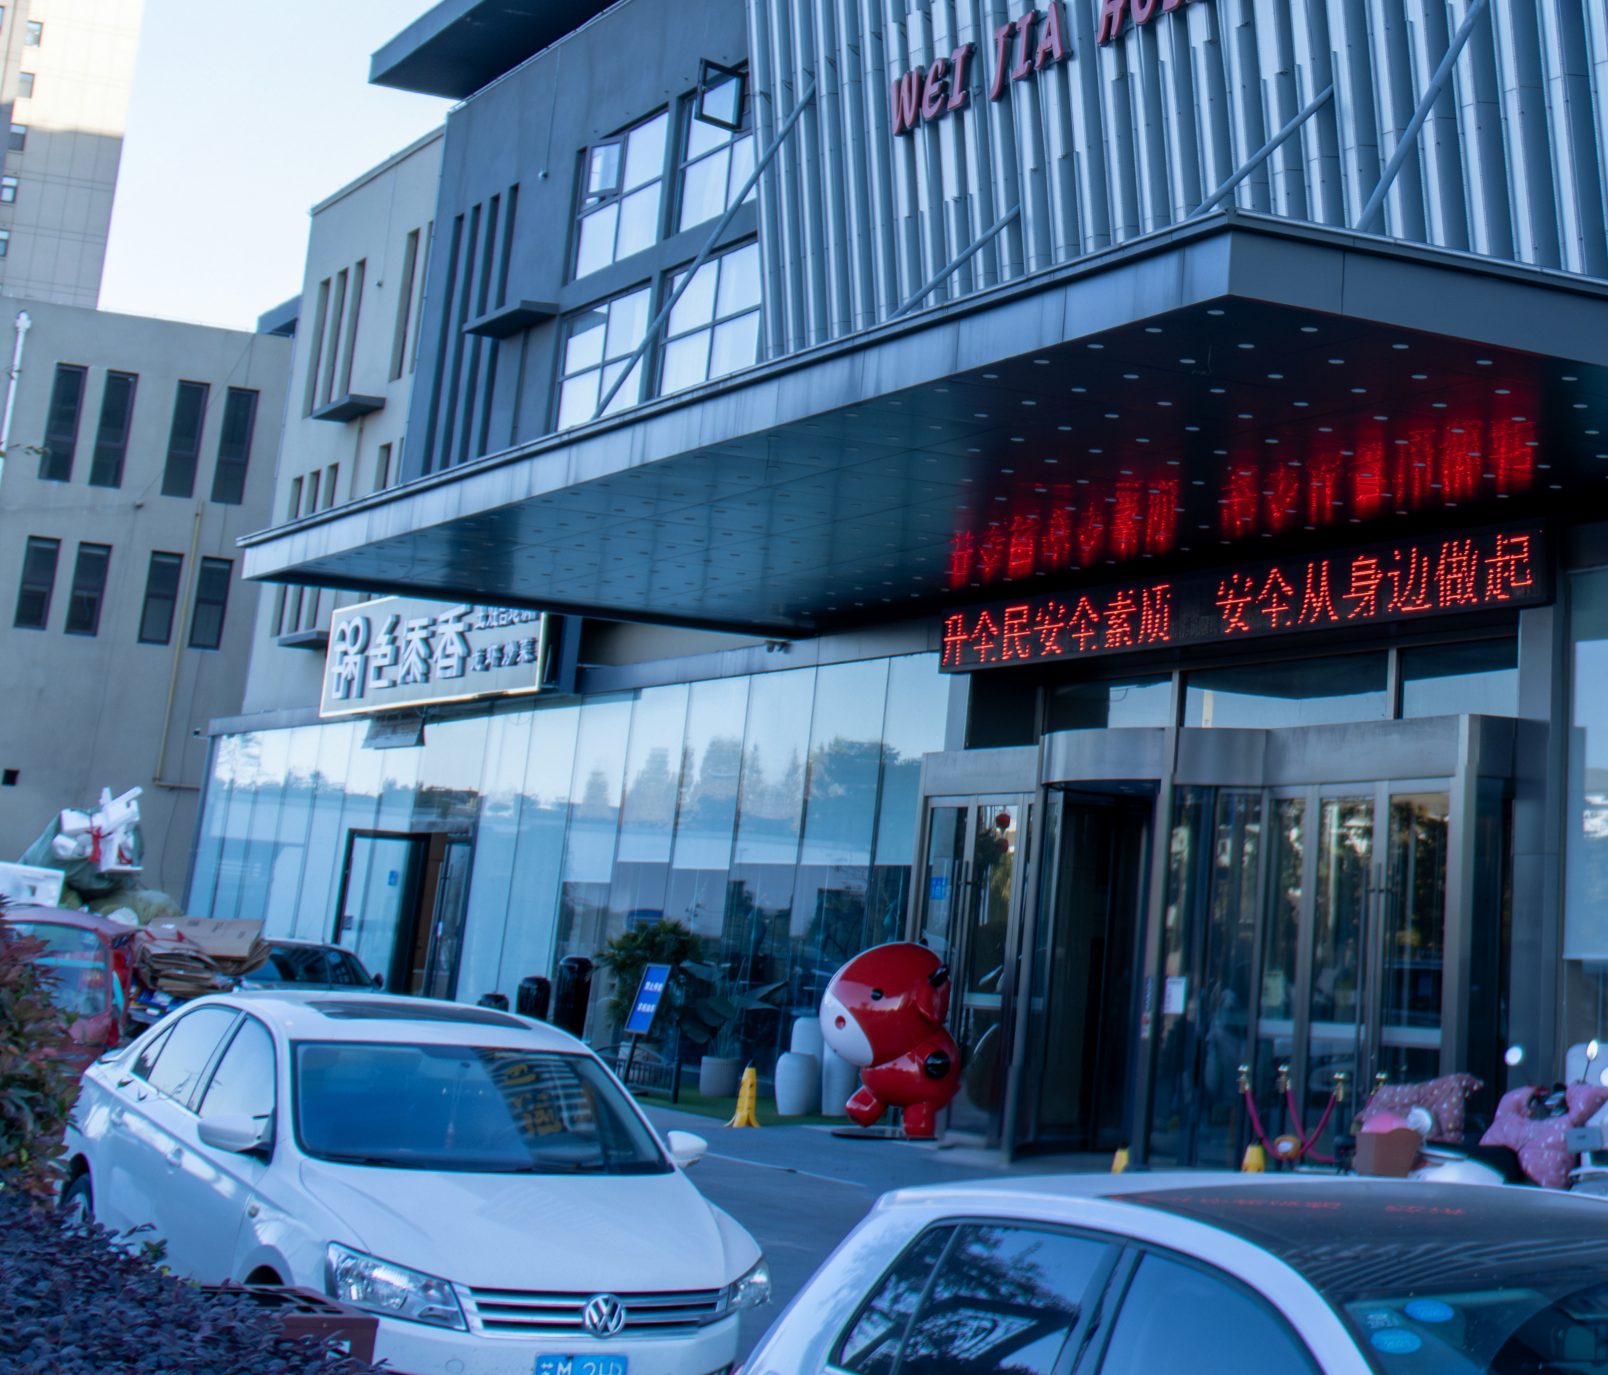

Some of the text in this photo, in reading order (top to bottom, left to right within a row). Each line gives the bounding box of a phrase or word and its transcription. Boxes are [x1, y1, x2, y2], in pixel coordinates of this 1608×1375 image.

[889, 42, 973, 136] WEI
[989, 0, 1066, 101] JIA
[1215, 533, 1533, 633] 安全从身边做起
